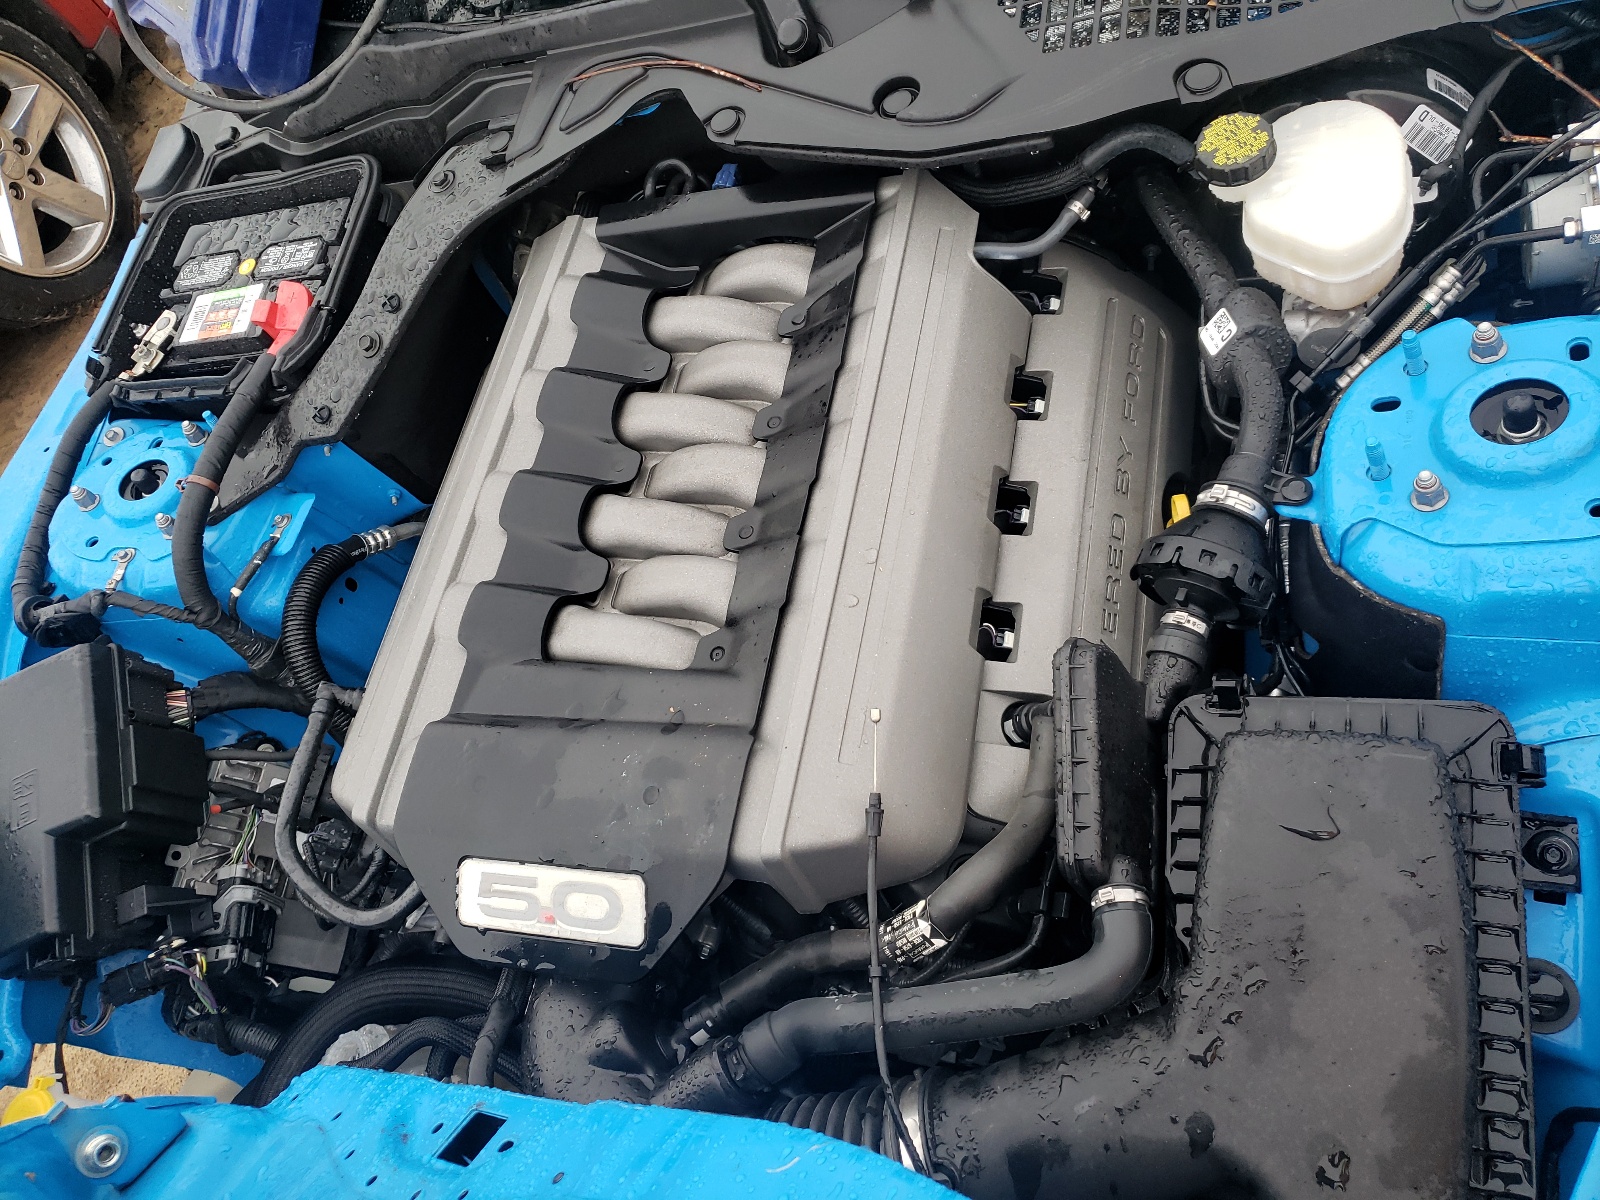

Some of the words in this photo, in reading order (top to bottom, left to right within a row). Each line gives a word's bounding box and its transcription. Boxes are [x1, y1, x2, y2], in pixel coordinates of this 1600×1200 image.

[1122, 314, 1145, 427] FORD
[1114, 435, 1133, 499] BY
[477, 872, 623, 932] 5.0
